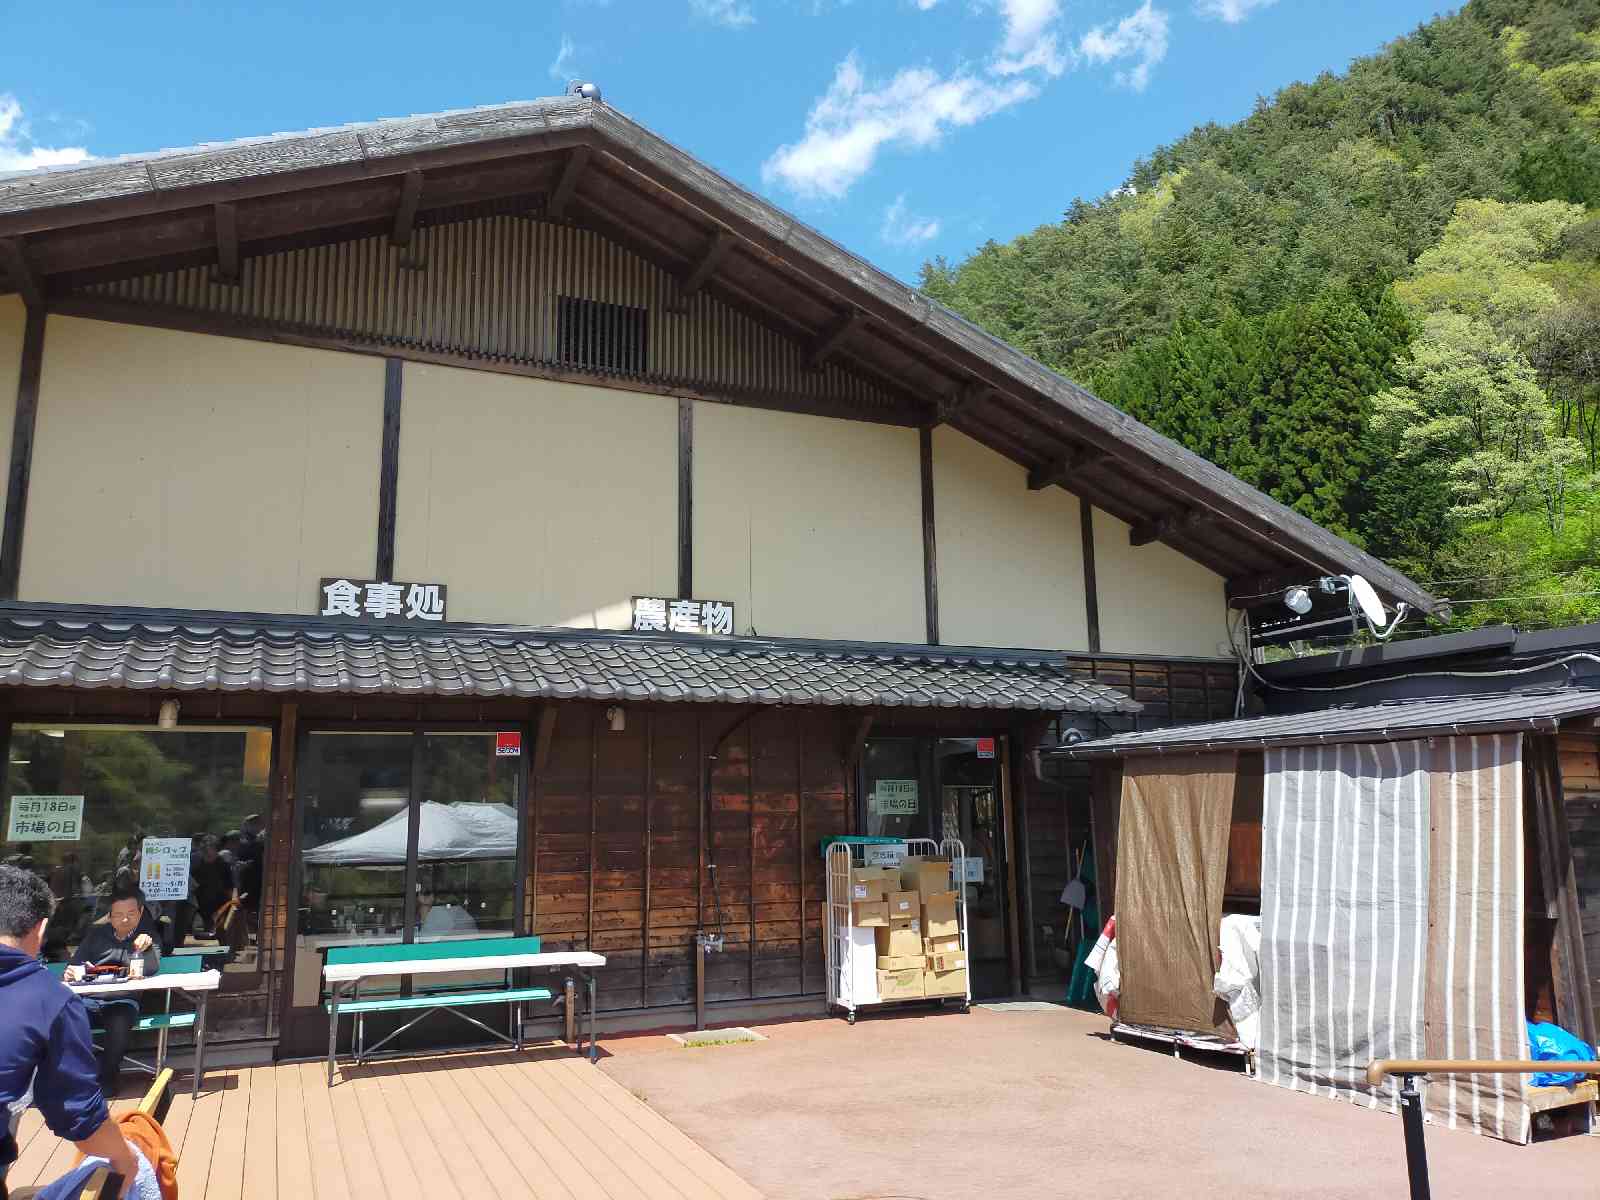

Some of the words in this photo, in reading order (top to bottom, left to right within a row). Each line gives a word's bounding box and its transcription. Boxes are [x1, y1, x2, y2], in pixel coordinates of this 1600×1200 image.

[322, 580, 444, 620] 食事処
[634, 598, 732, 634] 農産物
[15, 820, 76, 835] 市場の日
